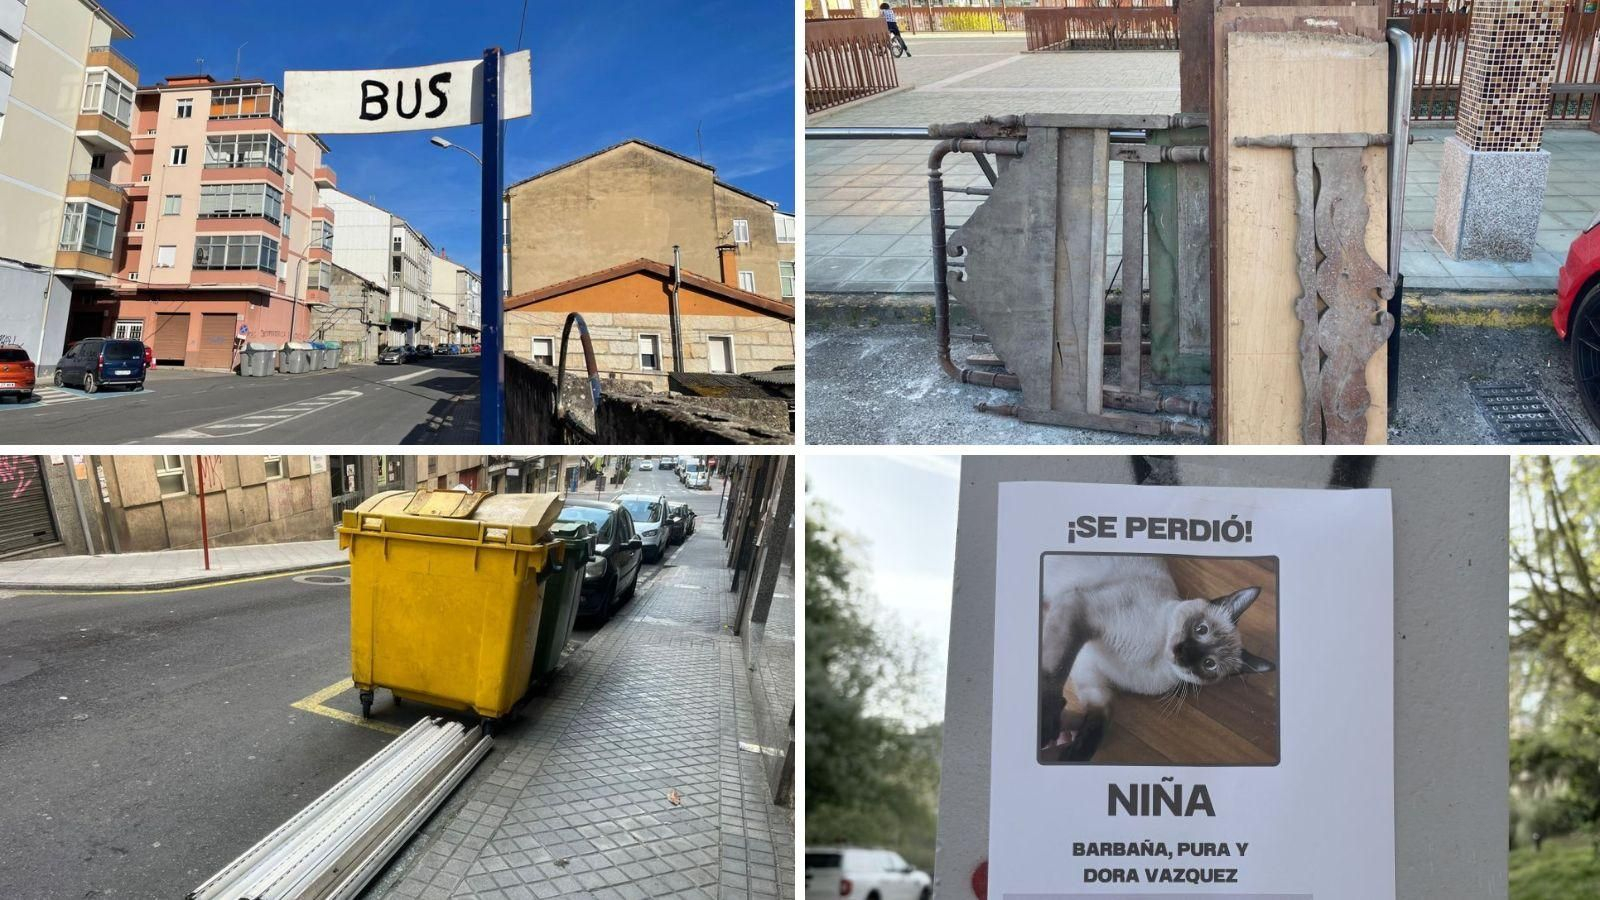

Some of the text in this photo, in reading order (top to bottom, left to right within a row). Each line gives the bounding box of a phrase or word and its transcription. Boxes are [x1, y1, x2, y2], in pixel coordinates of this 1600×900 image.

[359, 71, 452, 121] BUS
[1067, 514, 1253, 544] ¡SE PERDIÓ!
[1107, 776, 1217, 817] NIÑA
[1072, 839, 1249, 860] BARBAÑA, PURA Y
[1083, 867, 1238, 885] DORA VAZQUEZ
